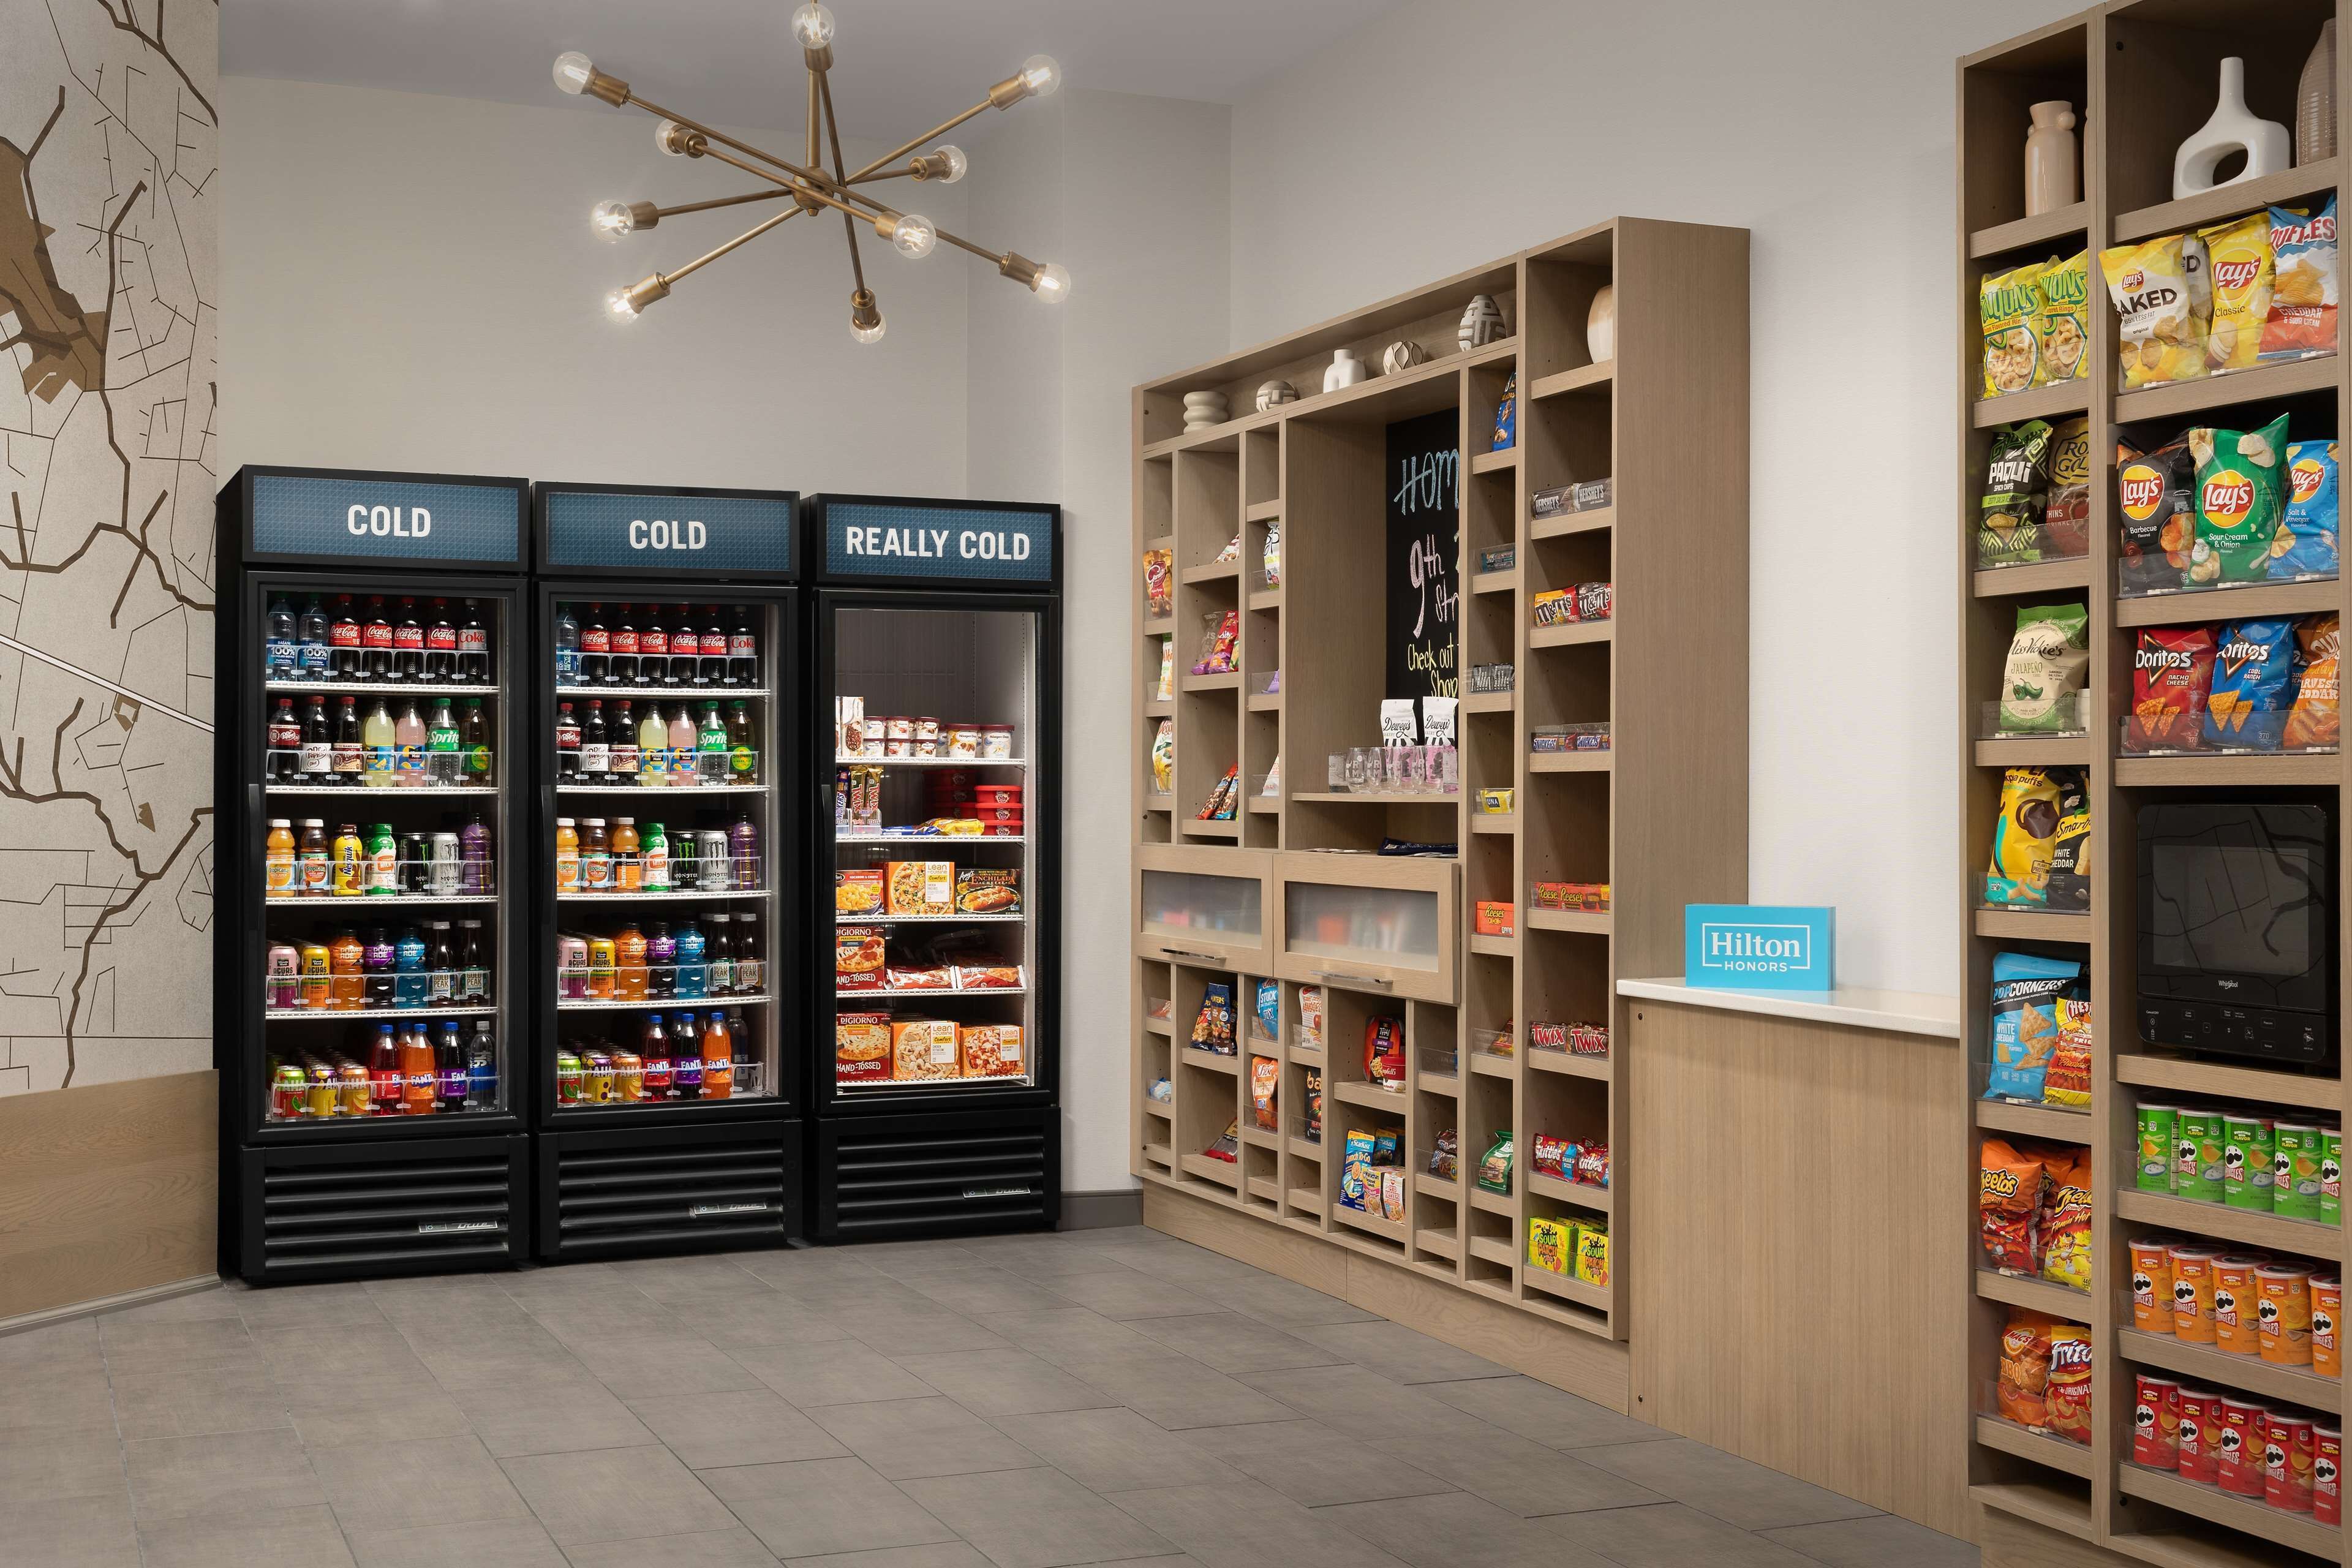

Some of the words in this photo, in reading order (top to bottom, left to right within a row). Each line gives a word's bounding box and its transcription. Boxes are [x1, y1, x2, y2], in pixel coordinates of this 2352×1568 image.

[2214, 255, 2261, 291] Lay's
[2122, 271, 2144, 290] Lay's
[2135, 314, 2147, 323] LESS
[2147, 311, 2156, 321] FAT
[2215, 304, 2245, 318] Classic
[2280, 306, 2323, 318] CHEDDAR
[2011, 317, 2027, 326] Rings
[2303, 318, 2320, 328] CREAM
[2057, 458, 2089, 473] GOL
[1578, 483, 1604, 502] HERSHEY'S
[2122, 477, 2161, 508] Lay's
[2204, 481, 2251, 515] Lay's
[1535, 495, 1559, 513] HERSHEY'S
[347, 503, 432, 539] COLD
[629, 519, 707, 551] COLD
[2130, 525, 2157, 534] Barbecue
[846, 525, 949, 559] REALLY
[959, 530, 1031, 562] COLD
[303, 648, 327, 657] 100%
[1408, 639, 1436, 671] Check
[1439, 643, 1453, 669] out
[2135, 649, 2193, 669] Doritos
[2011, 662, 2043, 674] JALAPEÑO
[431, 731, 459, 745] Sprite
[700, 732, 727, 746] Sprite
[1533, 737, 1558, 750] SNICKERS
[1577, 735, 1601, 748] SNICKERS
[2018, 775, 2043, 787] puffs
[1560, 887, 1583, 903] Reese's
[1485, 904, 1505, 918] Reese's
[1711, 932, 1801, 958] Hilton
[1724, 960, 1788, 973] HONORS
[1993, 979, 2067, 1001] POPCORNERS
[2218, 979, 2238, 990] Whirlpool
[1996, 1023, 2016, 1035] WHITE
[1578, 1155, 1604, 1172] kittles
[1980, 1169, 2017, 1196] heetos
[2074, 1212, 2092, 1223] Hot
[1539, 1232, 1557, 1245] SOUR
[1537, 1243, 1558, 1257] PATCH
[1586, 1246, 1604, 1258] SOUR
[1585, 1257, 1605, 1270] PATCH
[2000, 1356, 2021, 1385] BBQ
